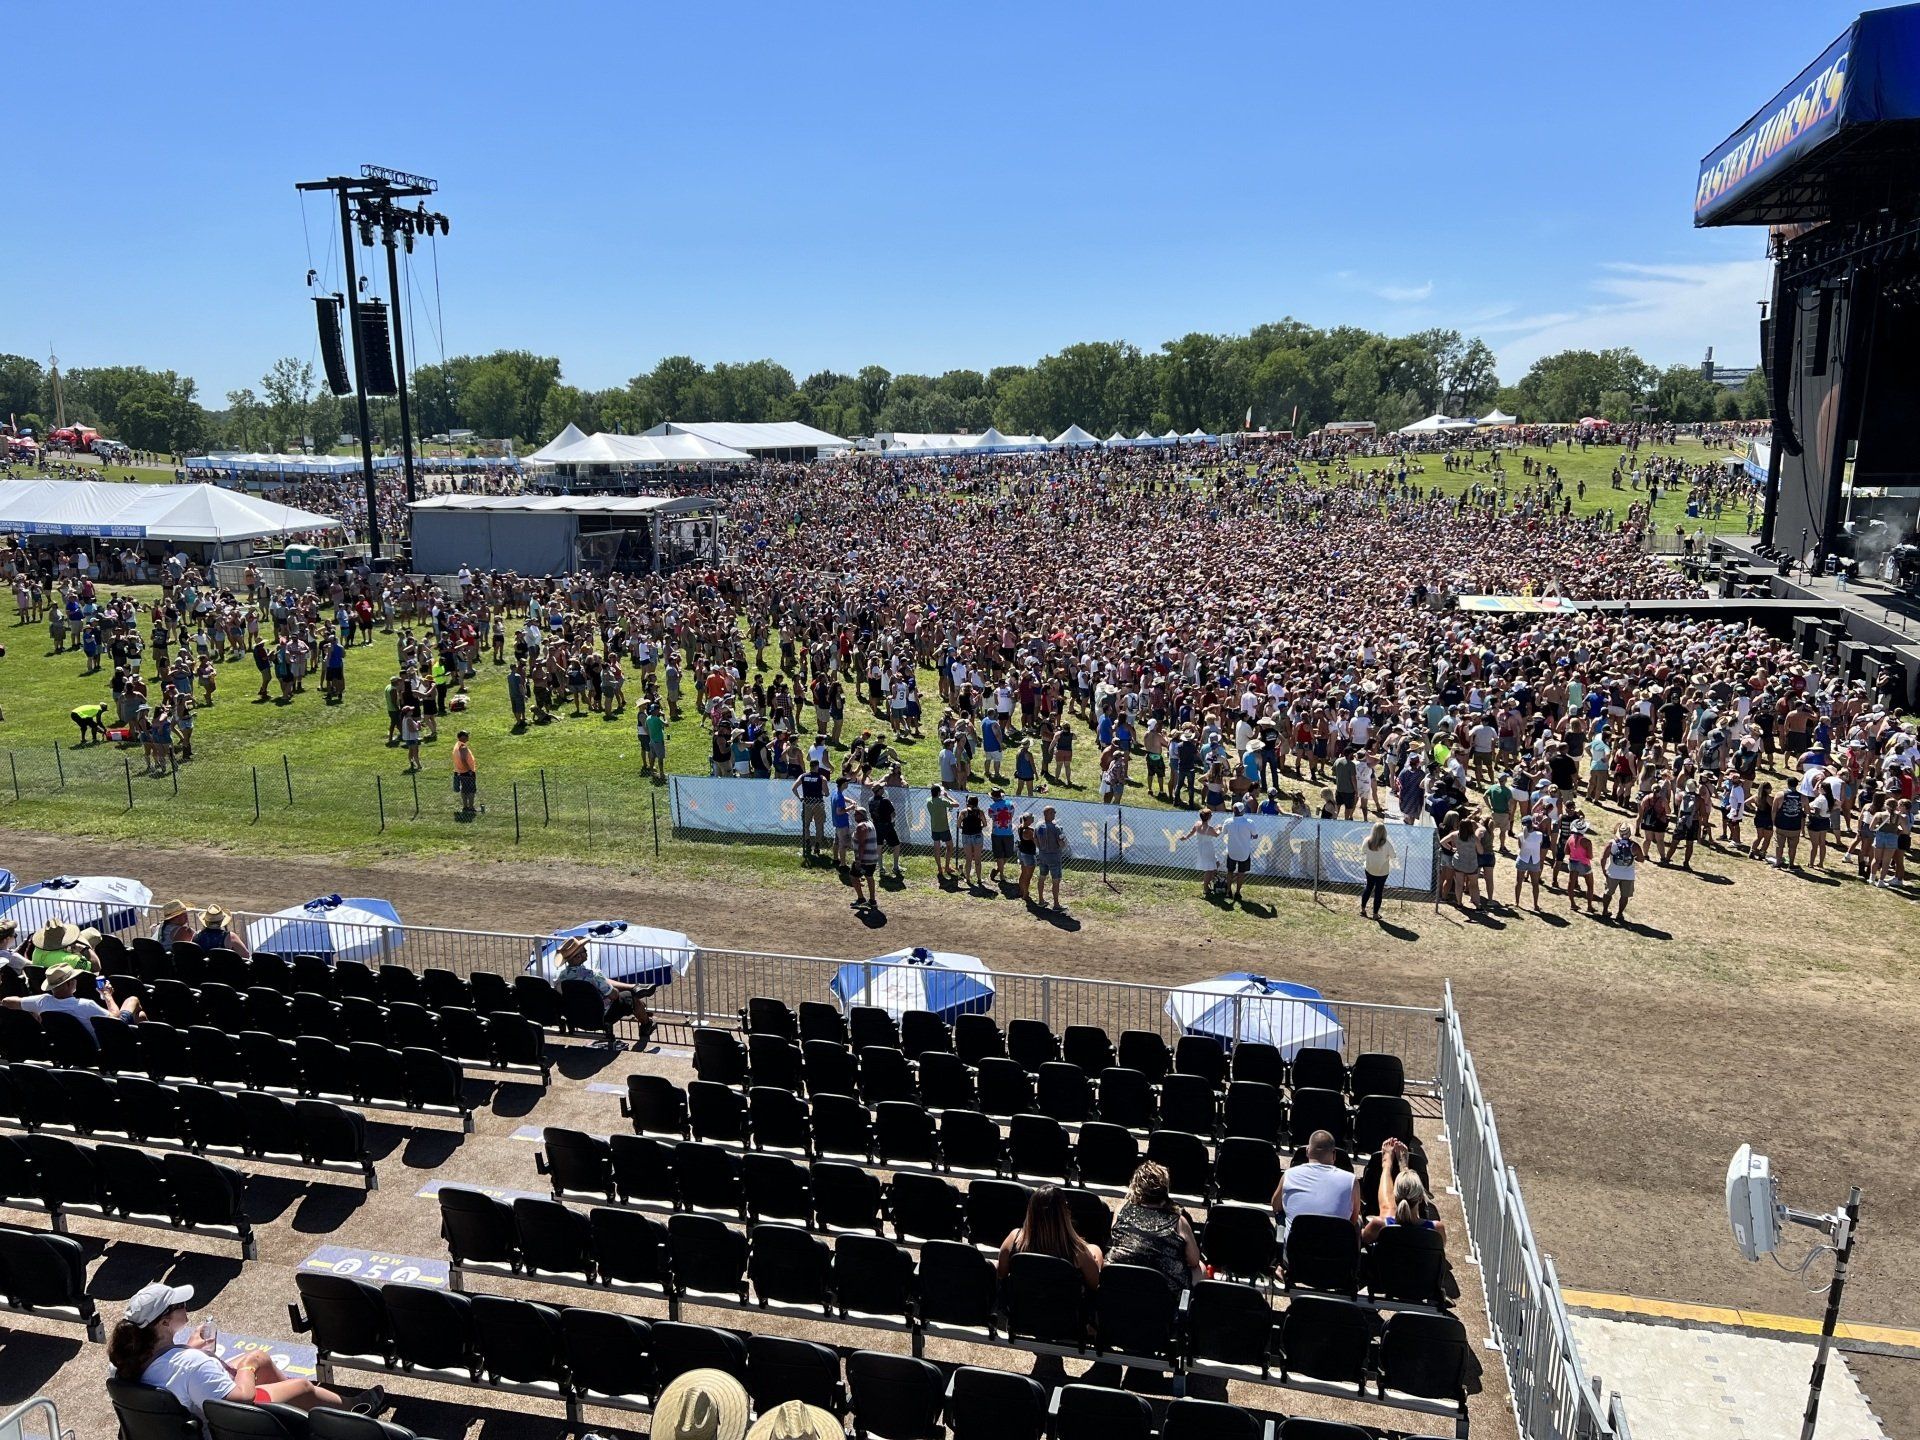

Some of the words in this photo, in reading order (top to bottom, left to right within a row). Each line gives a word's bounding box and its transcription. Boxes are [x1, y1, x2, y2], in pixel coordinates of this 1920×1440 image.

[1695, 132, 1757, 209] FASTER
[1749, 52, 1849, 172] HORSES
[369, 1255, 405, 1265] ROW
[336, 1262, 353, 1273] B
[361, 1264, 388, 1279] 5
[394, 1271, 410, 1281] A
[233, 1340, 273, 1352] ROW
